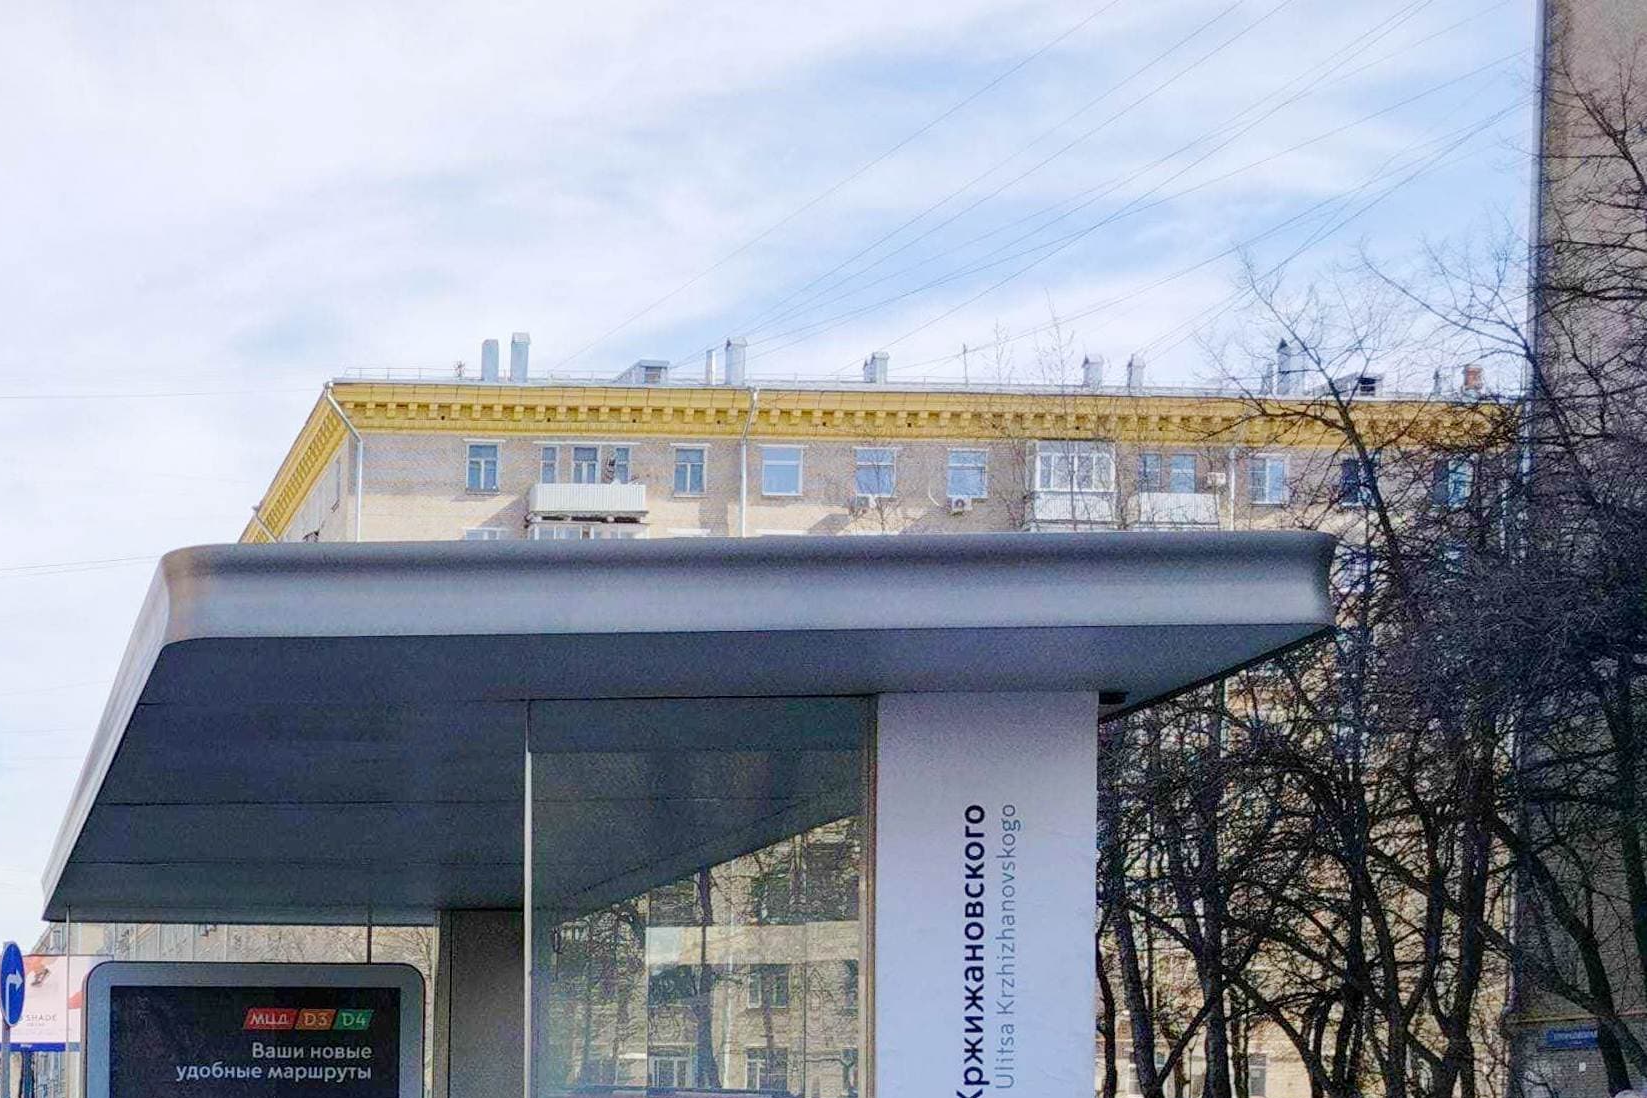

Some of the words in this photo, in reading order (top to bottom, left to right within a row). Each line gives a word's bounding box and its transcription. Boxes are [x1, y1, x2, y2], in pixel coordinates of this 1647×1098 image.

[995, 803, 1021, 1015] Krzhizhanovskogo
[250, 1012, 290, 1026] МЦД
[304, 1012, 327, 1026] D3
[341, 1012, 367, 1026] D4
[252, 1042, 305, 1059] Ваши
[310, 1045, 373, 1059] новые
[995, 1023, 1015, 1089] Ulitsa
[176, 1061, 263, 1082] удобные
[267, 1065, 372, 1082] маршруты
